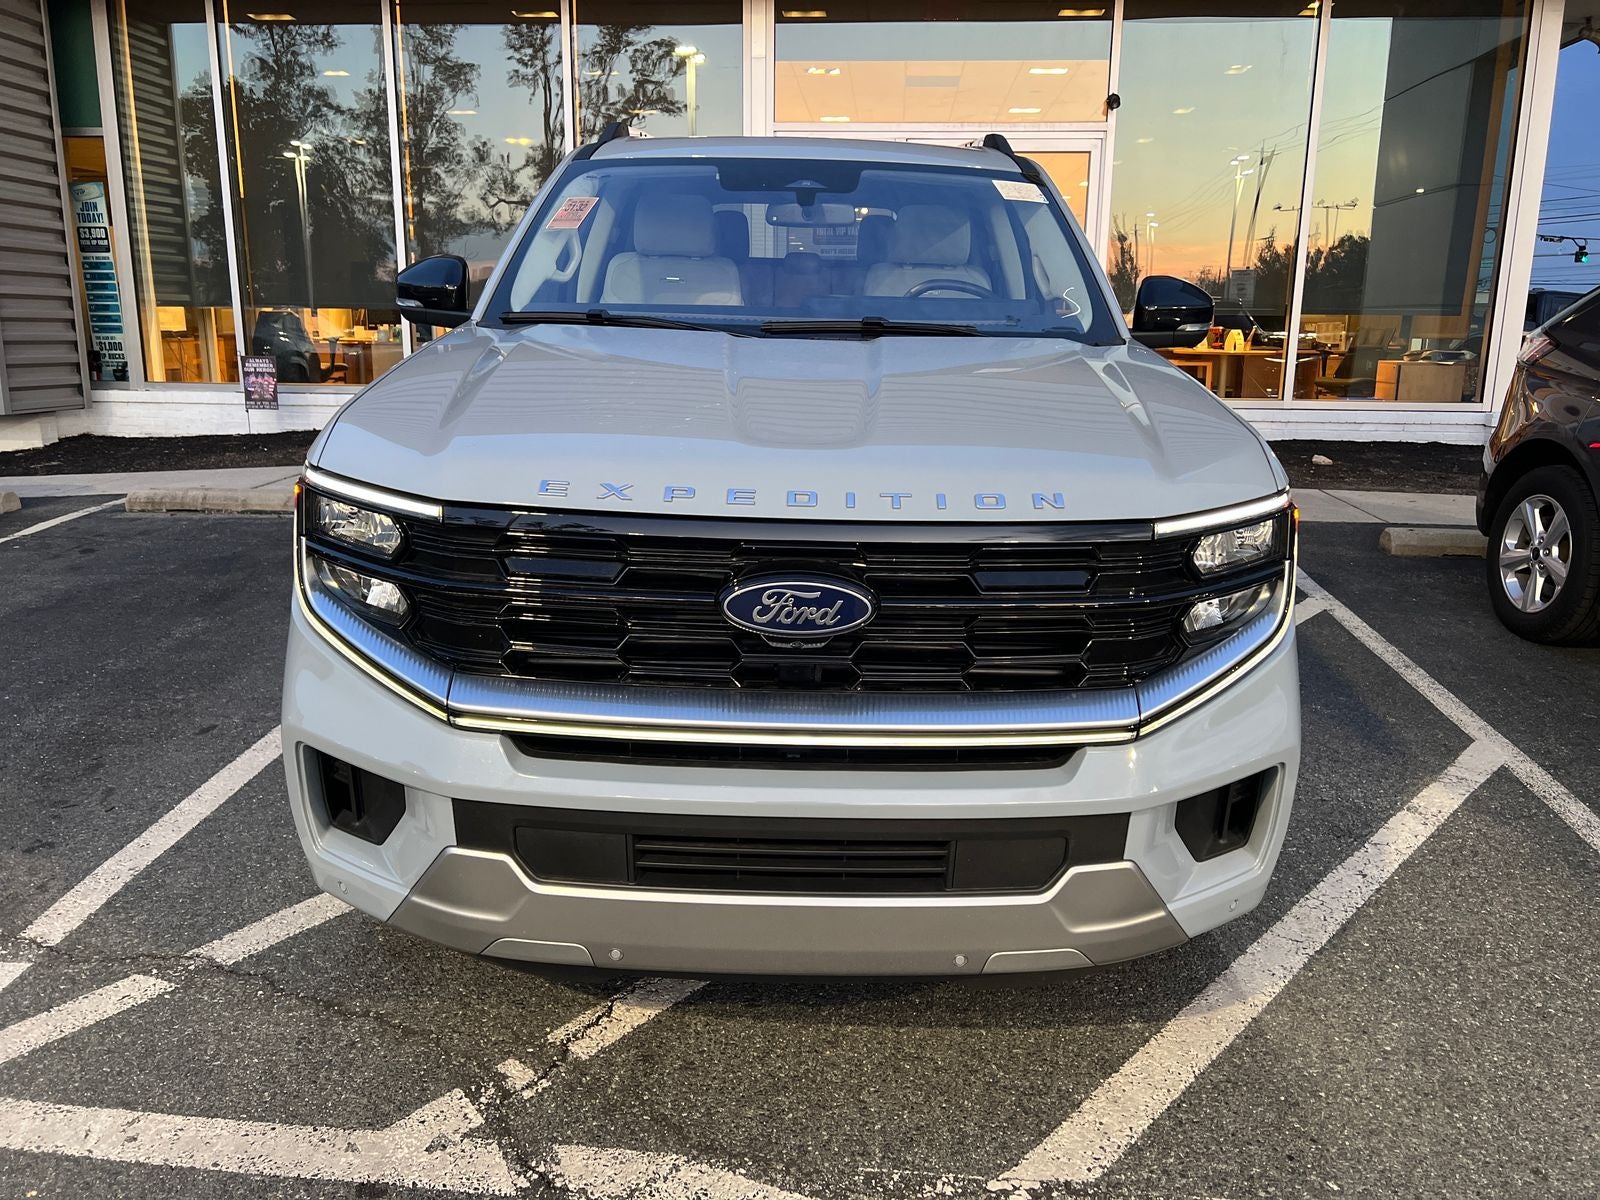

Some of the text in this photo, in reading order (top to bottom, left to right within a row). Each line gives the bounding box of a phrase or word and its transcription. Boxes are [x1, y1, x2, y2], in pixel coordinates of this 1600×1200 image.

[80, 201, 98, 212] JOIN
[76, 212, 105, 223] TODAY!
[80, 228, 106, 239] $3,900
[98, 341, 123, 352] $1,000
[537, 479, 1067, 510] EXPEDITION
[752, 588, 844, 626] Ford
